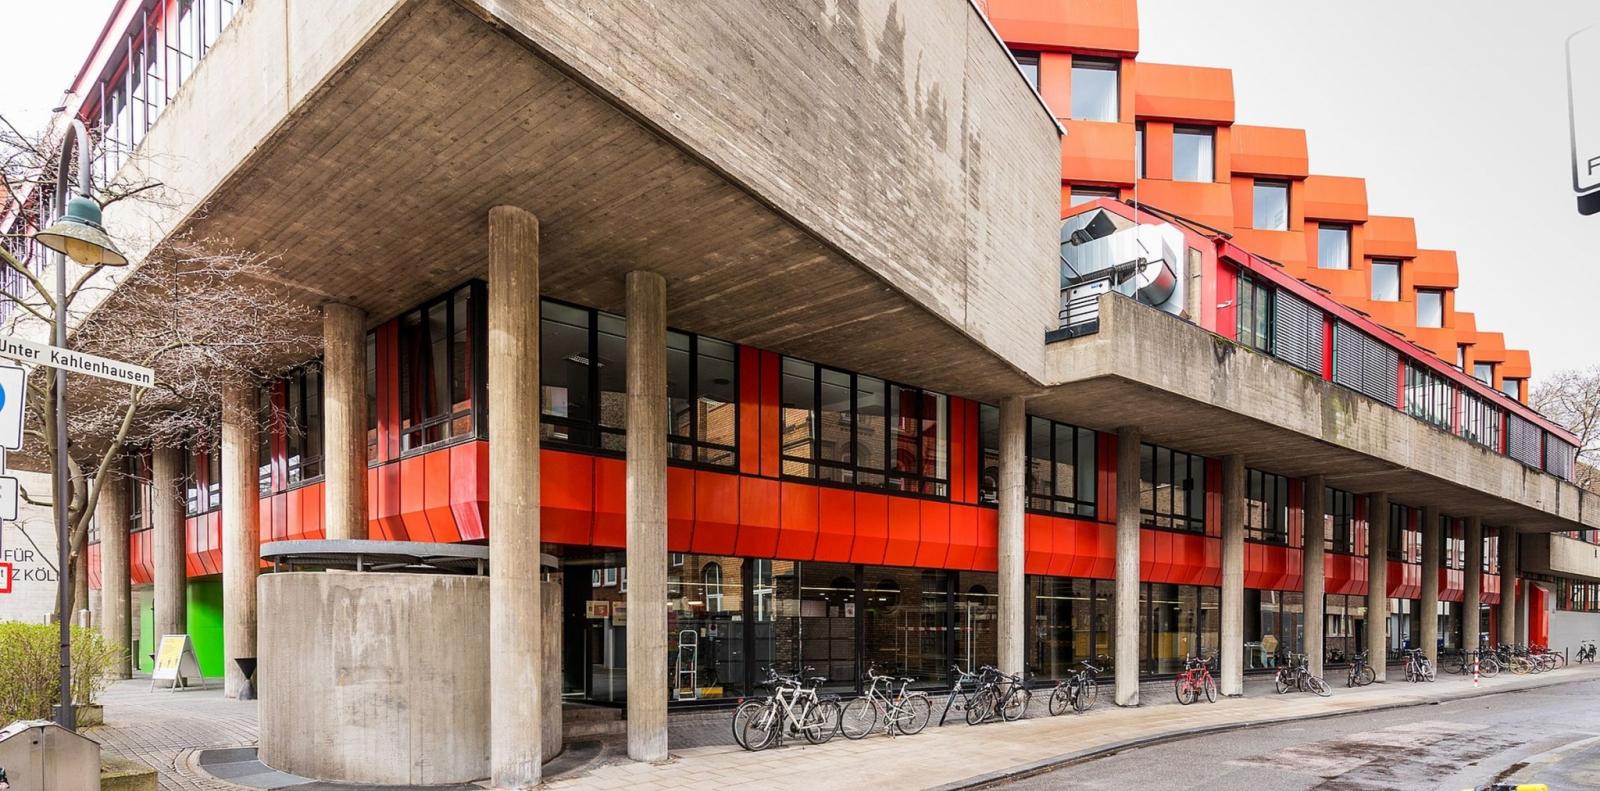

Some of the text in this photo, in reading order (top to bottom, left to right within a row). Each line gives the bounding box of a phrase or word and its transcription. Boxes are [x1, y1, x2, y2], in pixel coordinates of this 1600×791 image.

[0, 339, 150, 383] Unter Kahlenhausen
[4, 547, 34, 562] FÜR
